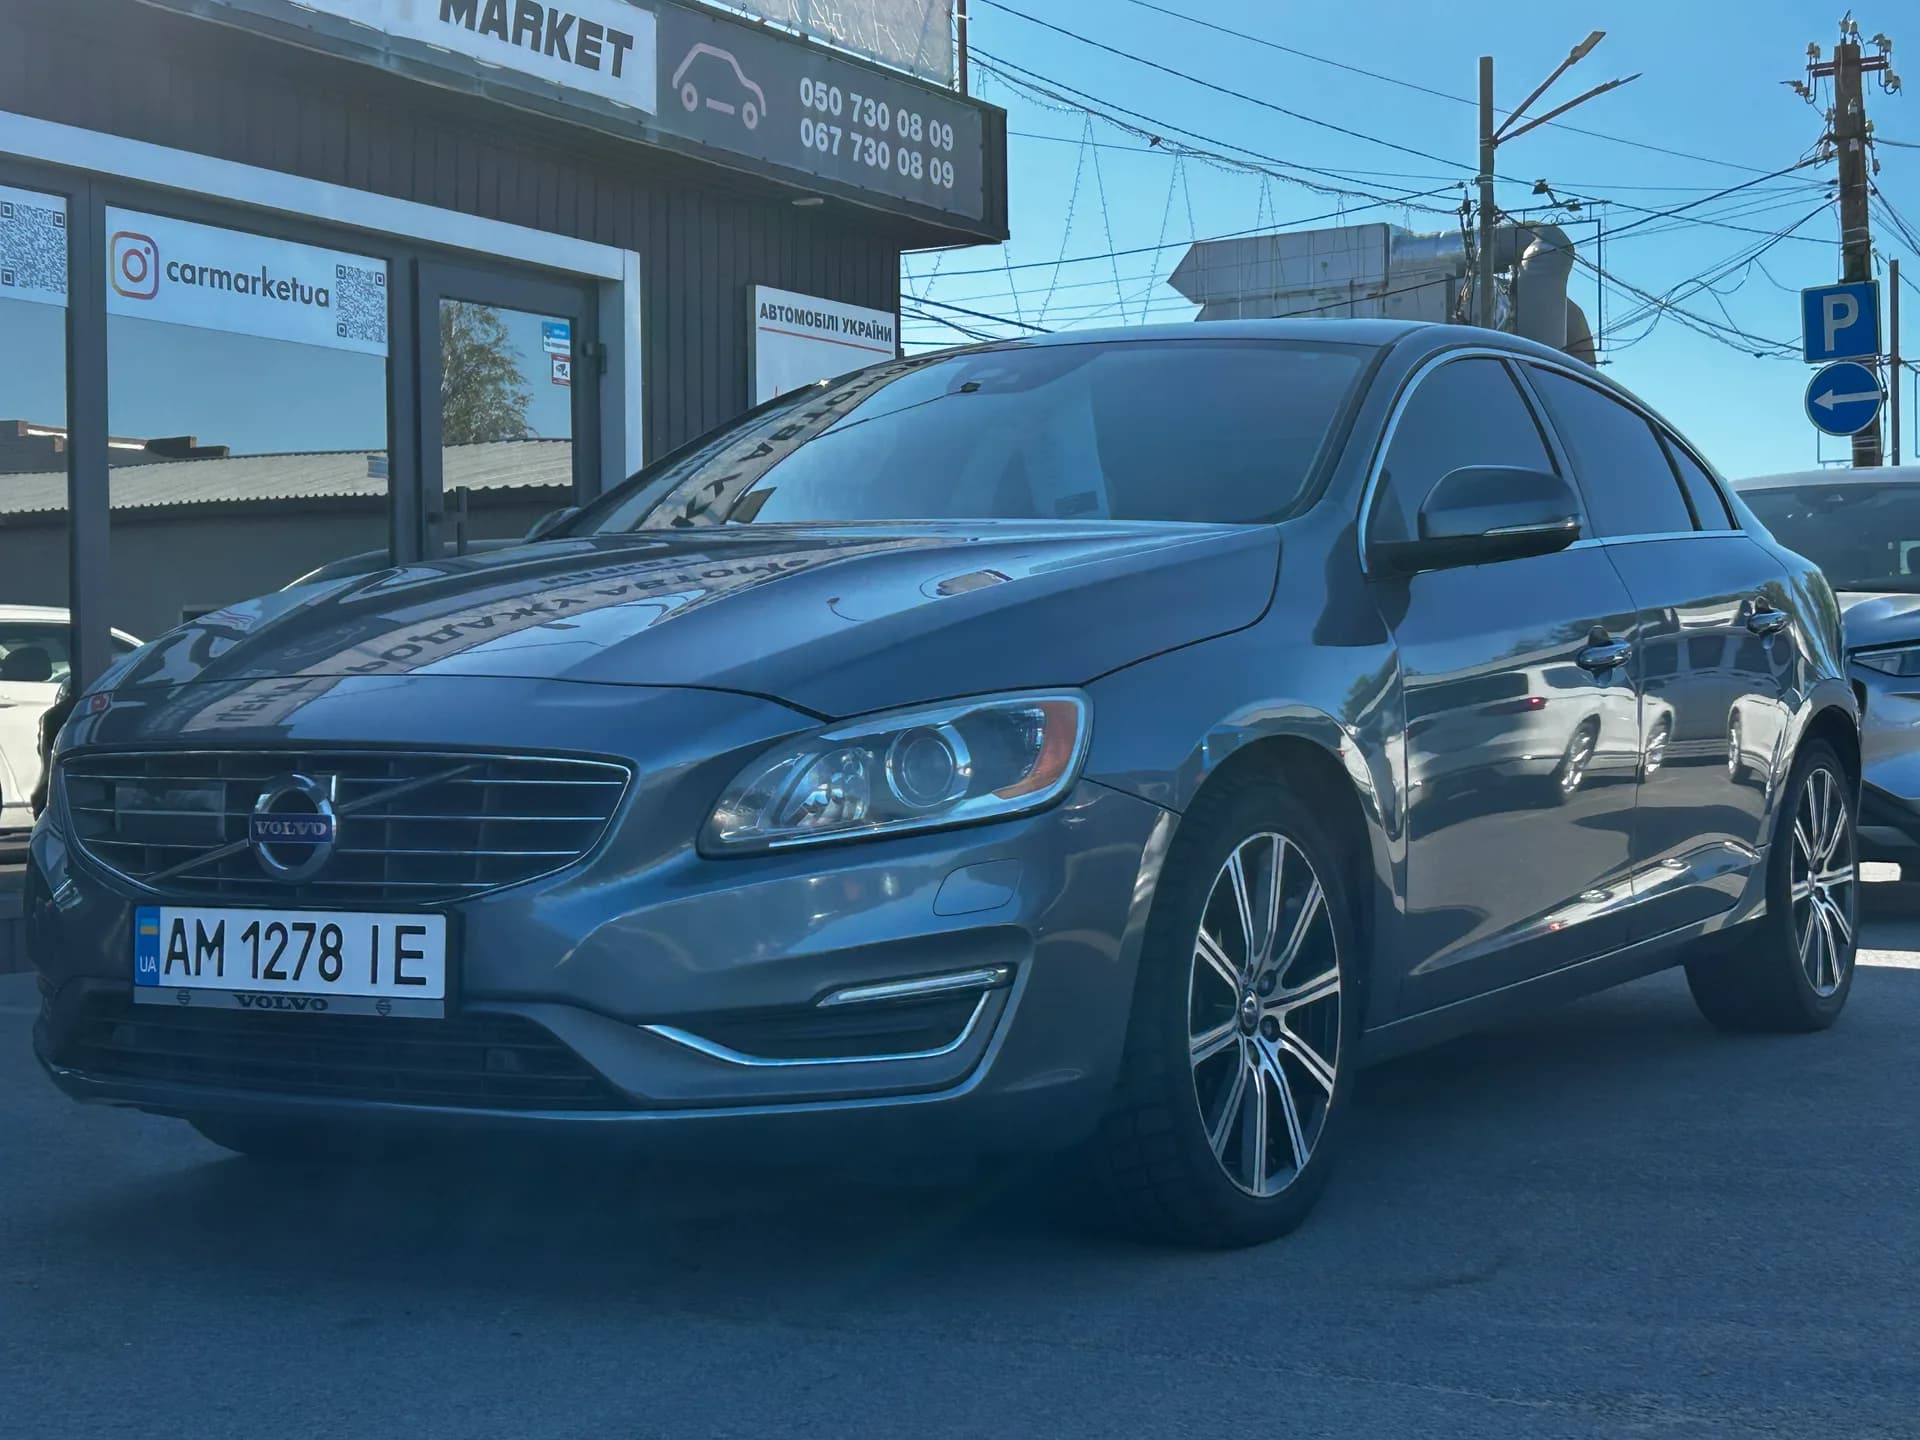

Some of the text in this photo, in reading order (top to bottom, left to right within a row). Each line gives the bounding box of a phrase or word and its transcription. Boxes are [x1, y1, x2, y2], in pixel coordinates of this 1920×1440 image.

[439, 0, 634, 78] MARKET
[800, 77, 954, 151] 050 730 08 09
[801, 118, 954, 189] 067 730 08 09
[166, 261, 330, 308] carmarketua
[760, 302, 892, 343] АВТОМОБІЛІ УКРАЇНИ
[1823, 294, 1859, 352] P
[255, 821, 327, 835] VOLVO
[140, 957, 157, 973] UA
[164, 918, 426, 986] AM 1278 IE
[232, 993, 329, 1012] VOLVO
